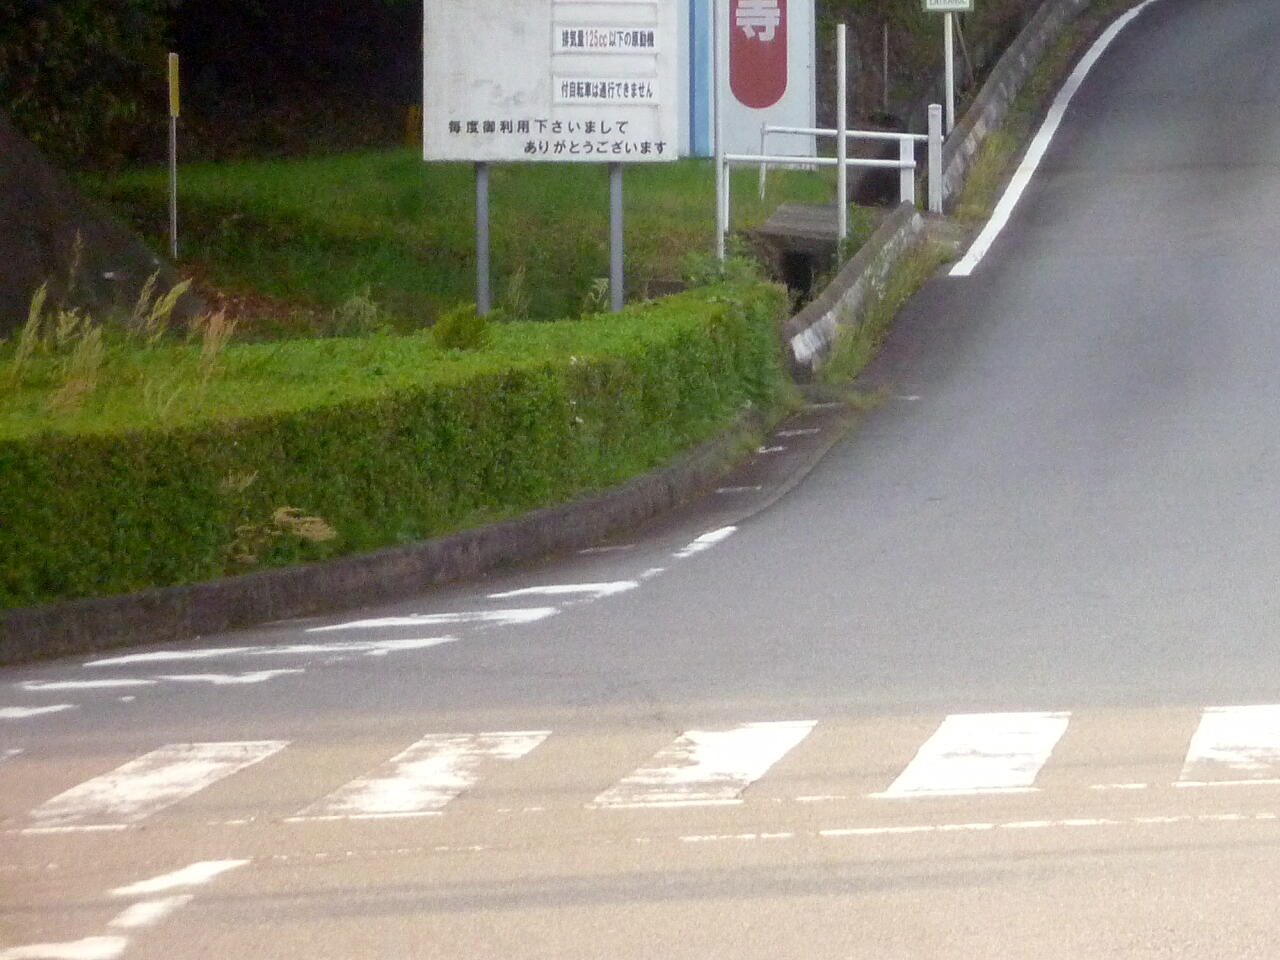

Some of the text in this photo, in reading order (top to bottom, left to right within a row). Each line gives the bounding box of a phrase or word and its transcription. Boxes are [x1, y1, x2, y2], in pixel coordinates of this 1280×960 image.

[448, 119, 629, 134] 毎度御利用下さいまして
[523, 139, 667, 155] ありがとうございます
